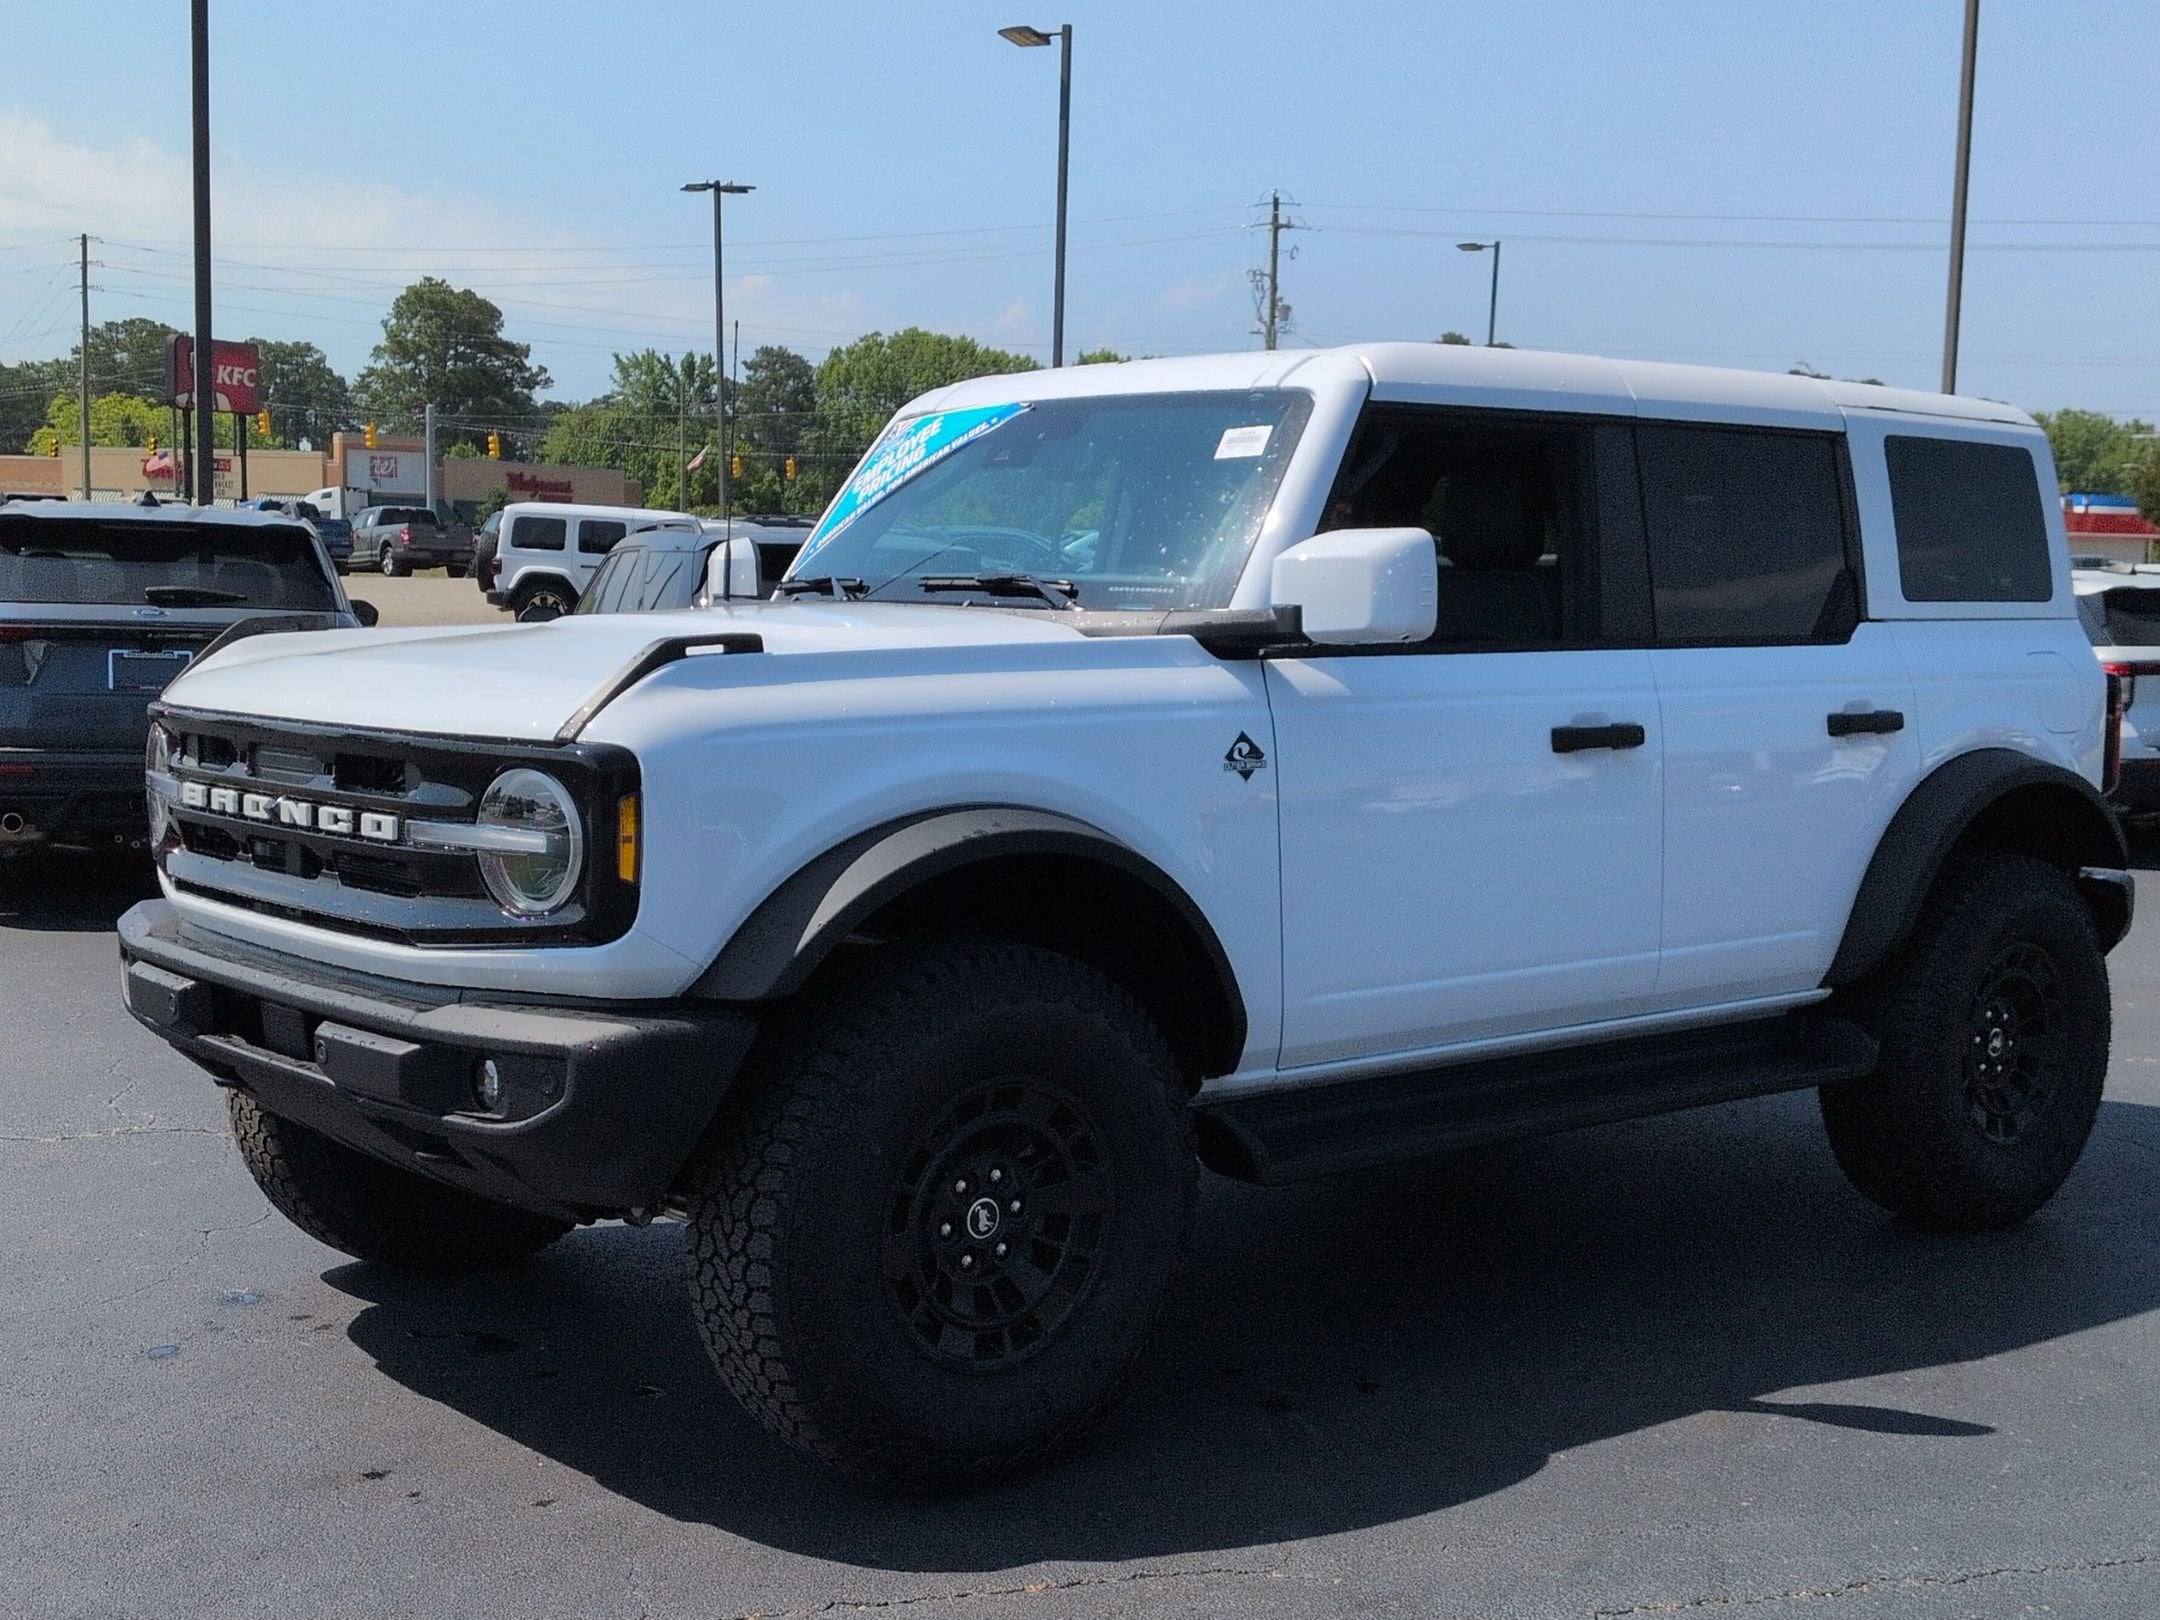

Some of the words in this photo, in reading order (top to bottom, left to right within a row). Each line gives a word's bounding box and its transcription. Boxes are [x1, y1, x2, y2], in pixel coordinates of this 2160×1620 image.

[215, 364, 257, 388] KFC
[854, 415, 945, 493] EMPLOYEE
[856, 443, 927, 504] PRICING
[181, 780, 398, 842] BRONCO
